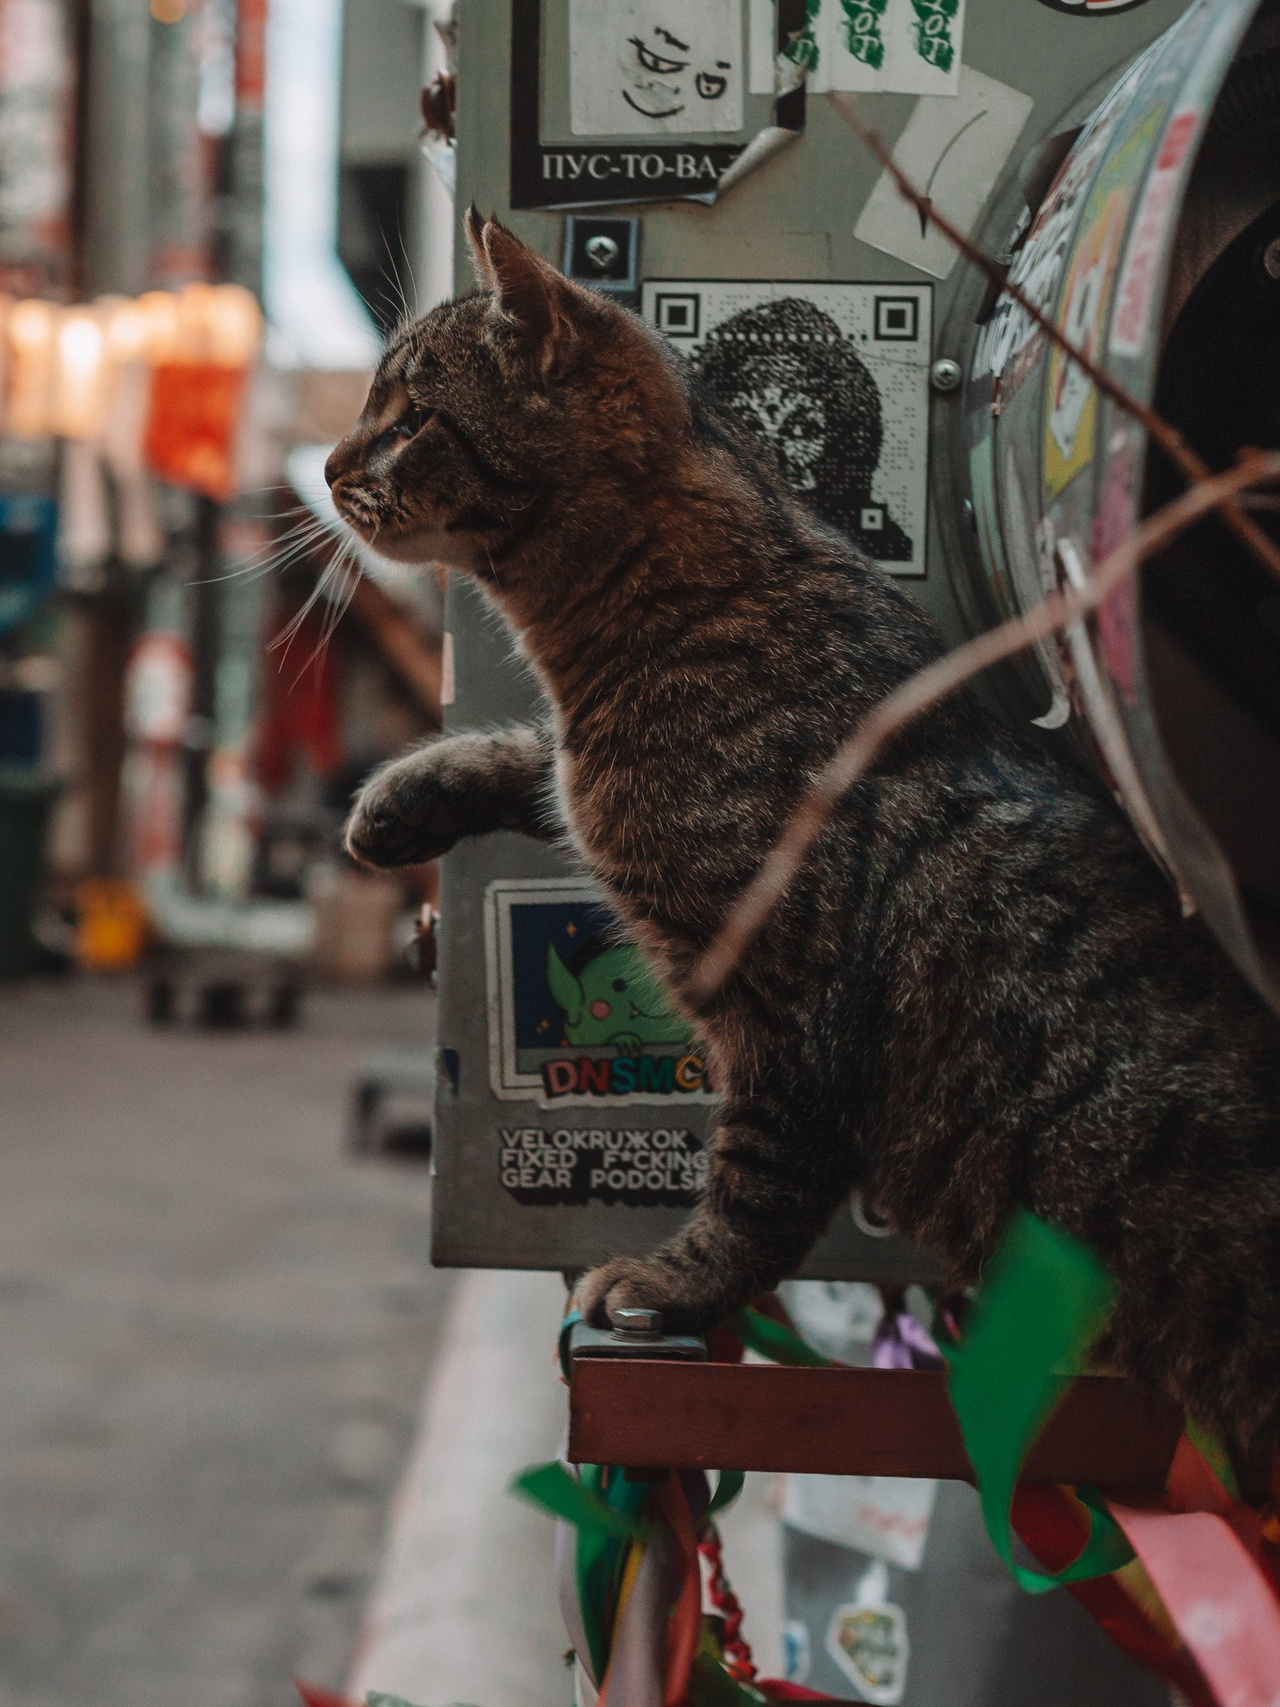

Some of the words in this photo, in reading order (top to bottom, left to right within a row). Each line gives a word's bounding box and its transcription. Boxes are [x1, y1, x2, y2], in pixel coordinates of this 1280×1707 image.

[543, 154, 739, 179] ПУС-ТО-ВА-
[502, 1151, 578, 1168] FIXED
[502, 1169, 572, 1188] GEAR
